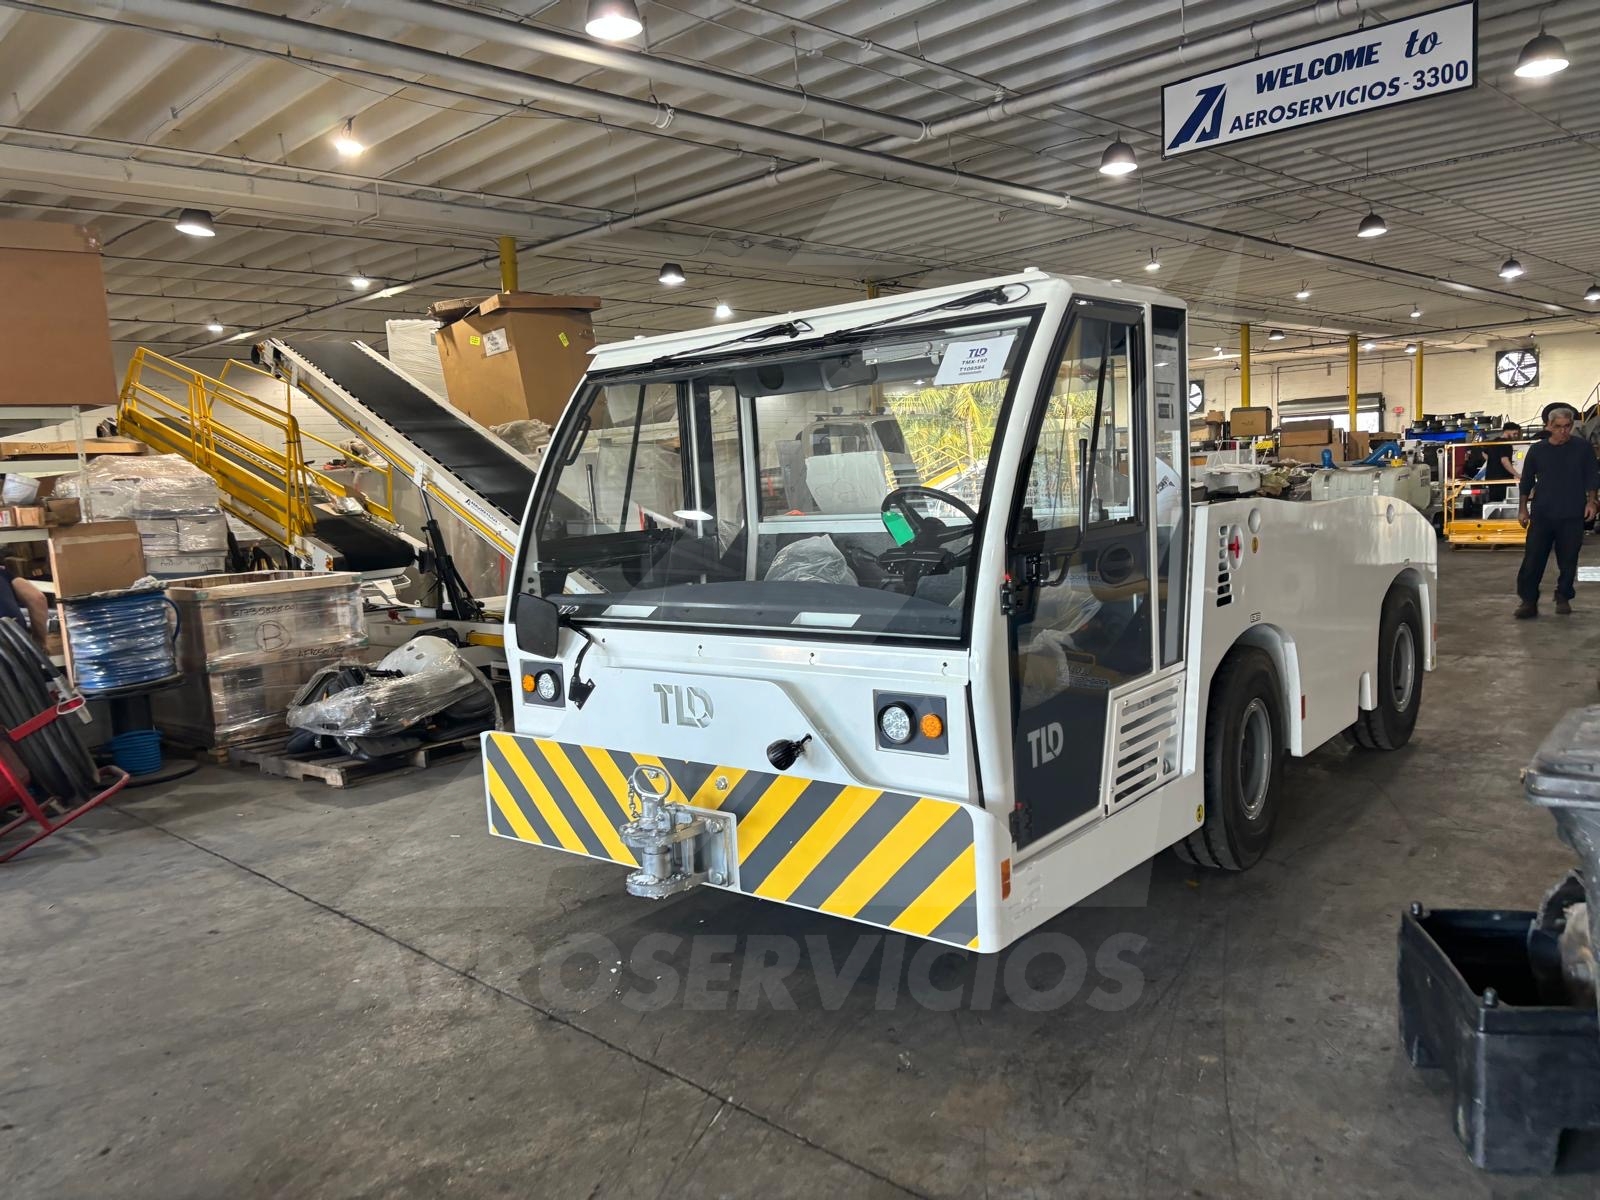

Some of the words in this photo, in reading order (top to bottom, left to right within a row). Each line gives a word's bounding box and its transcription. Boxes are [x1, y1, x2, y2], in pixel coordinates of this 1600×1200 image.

[1255, 41, 1383, 95] WELCOME
[1404, 29, 1442, 58] to
[969, 347, 988, 358] TLD
[653, 683, 714, 729] TLD
[1027, 721, 1064, 768] TLD
